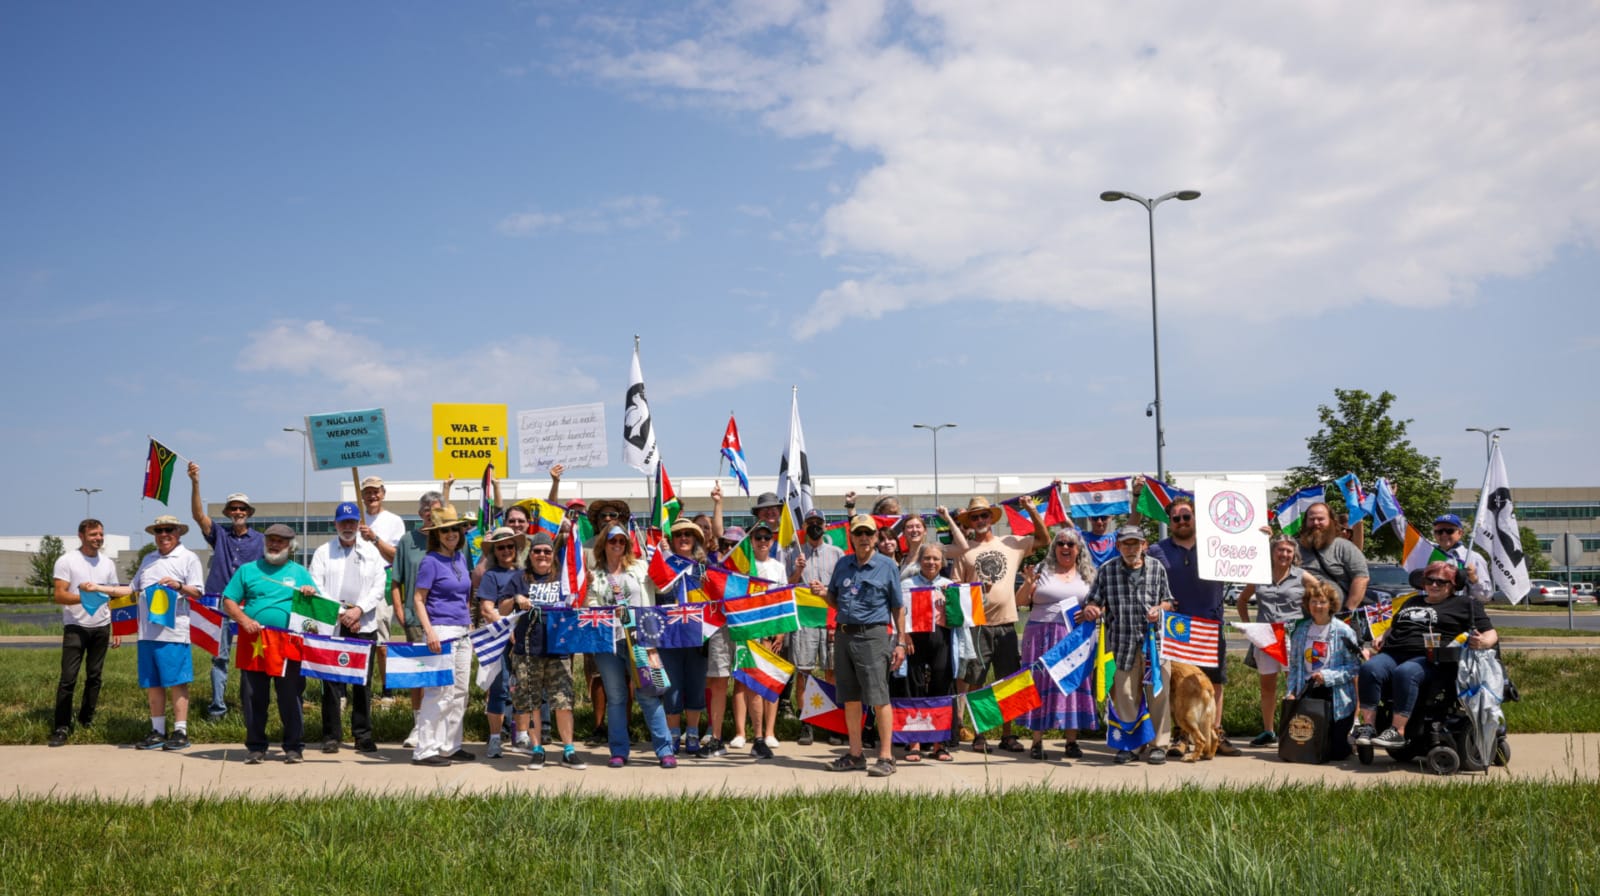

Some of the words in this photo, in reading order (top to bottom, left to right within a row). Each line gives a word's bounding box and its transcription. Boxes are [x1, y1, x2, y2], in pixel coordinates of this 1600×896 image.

[326, 415, 364, 426] NUCLEAR
[326, 427, 368, 438] WEAPONS
[450, 424, 478, 432] WAR
[344, 440, 361, 448] ARE
[444, 437, 497, 445] CLIMATE
[341, 450, 372, 460] ILLEGAL
[451, 450, 492, 458] CHAOS
[1207, 536, 1258, 560] Peace
[1215, 559, 1253, 577] Now
[529, 581, 560, 592] CHAS
